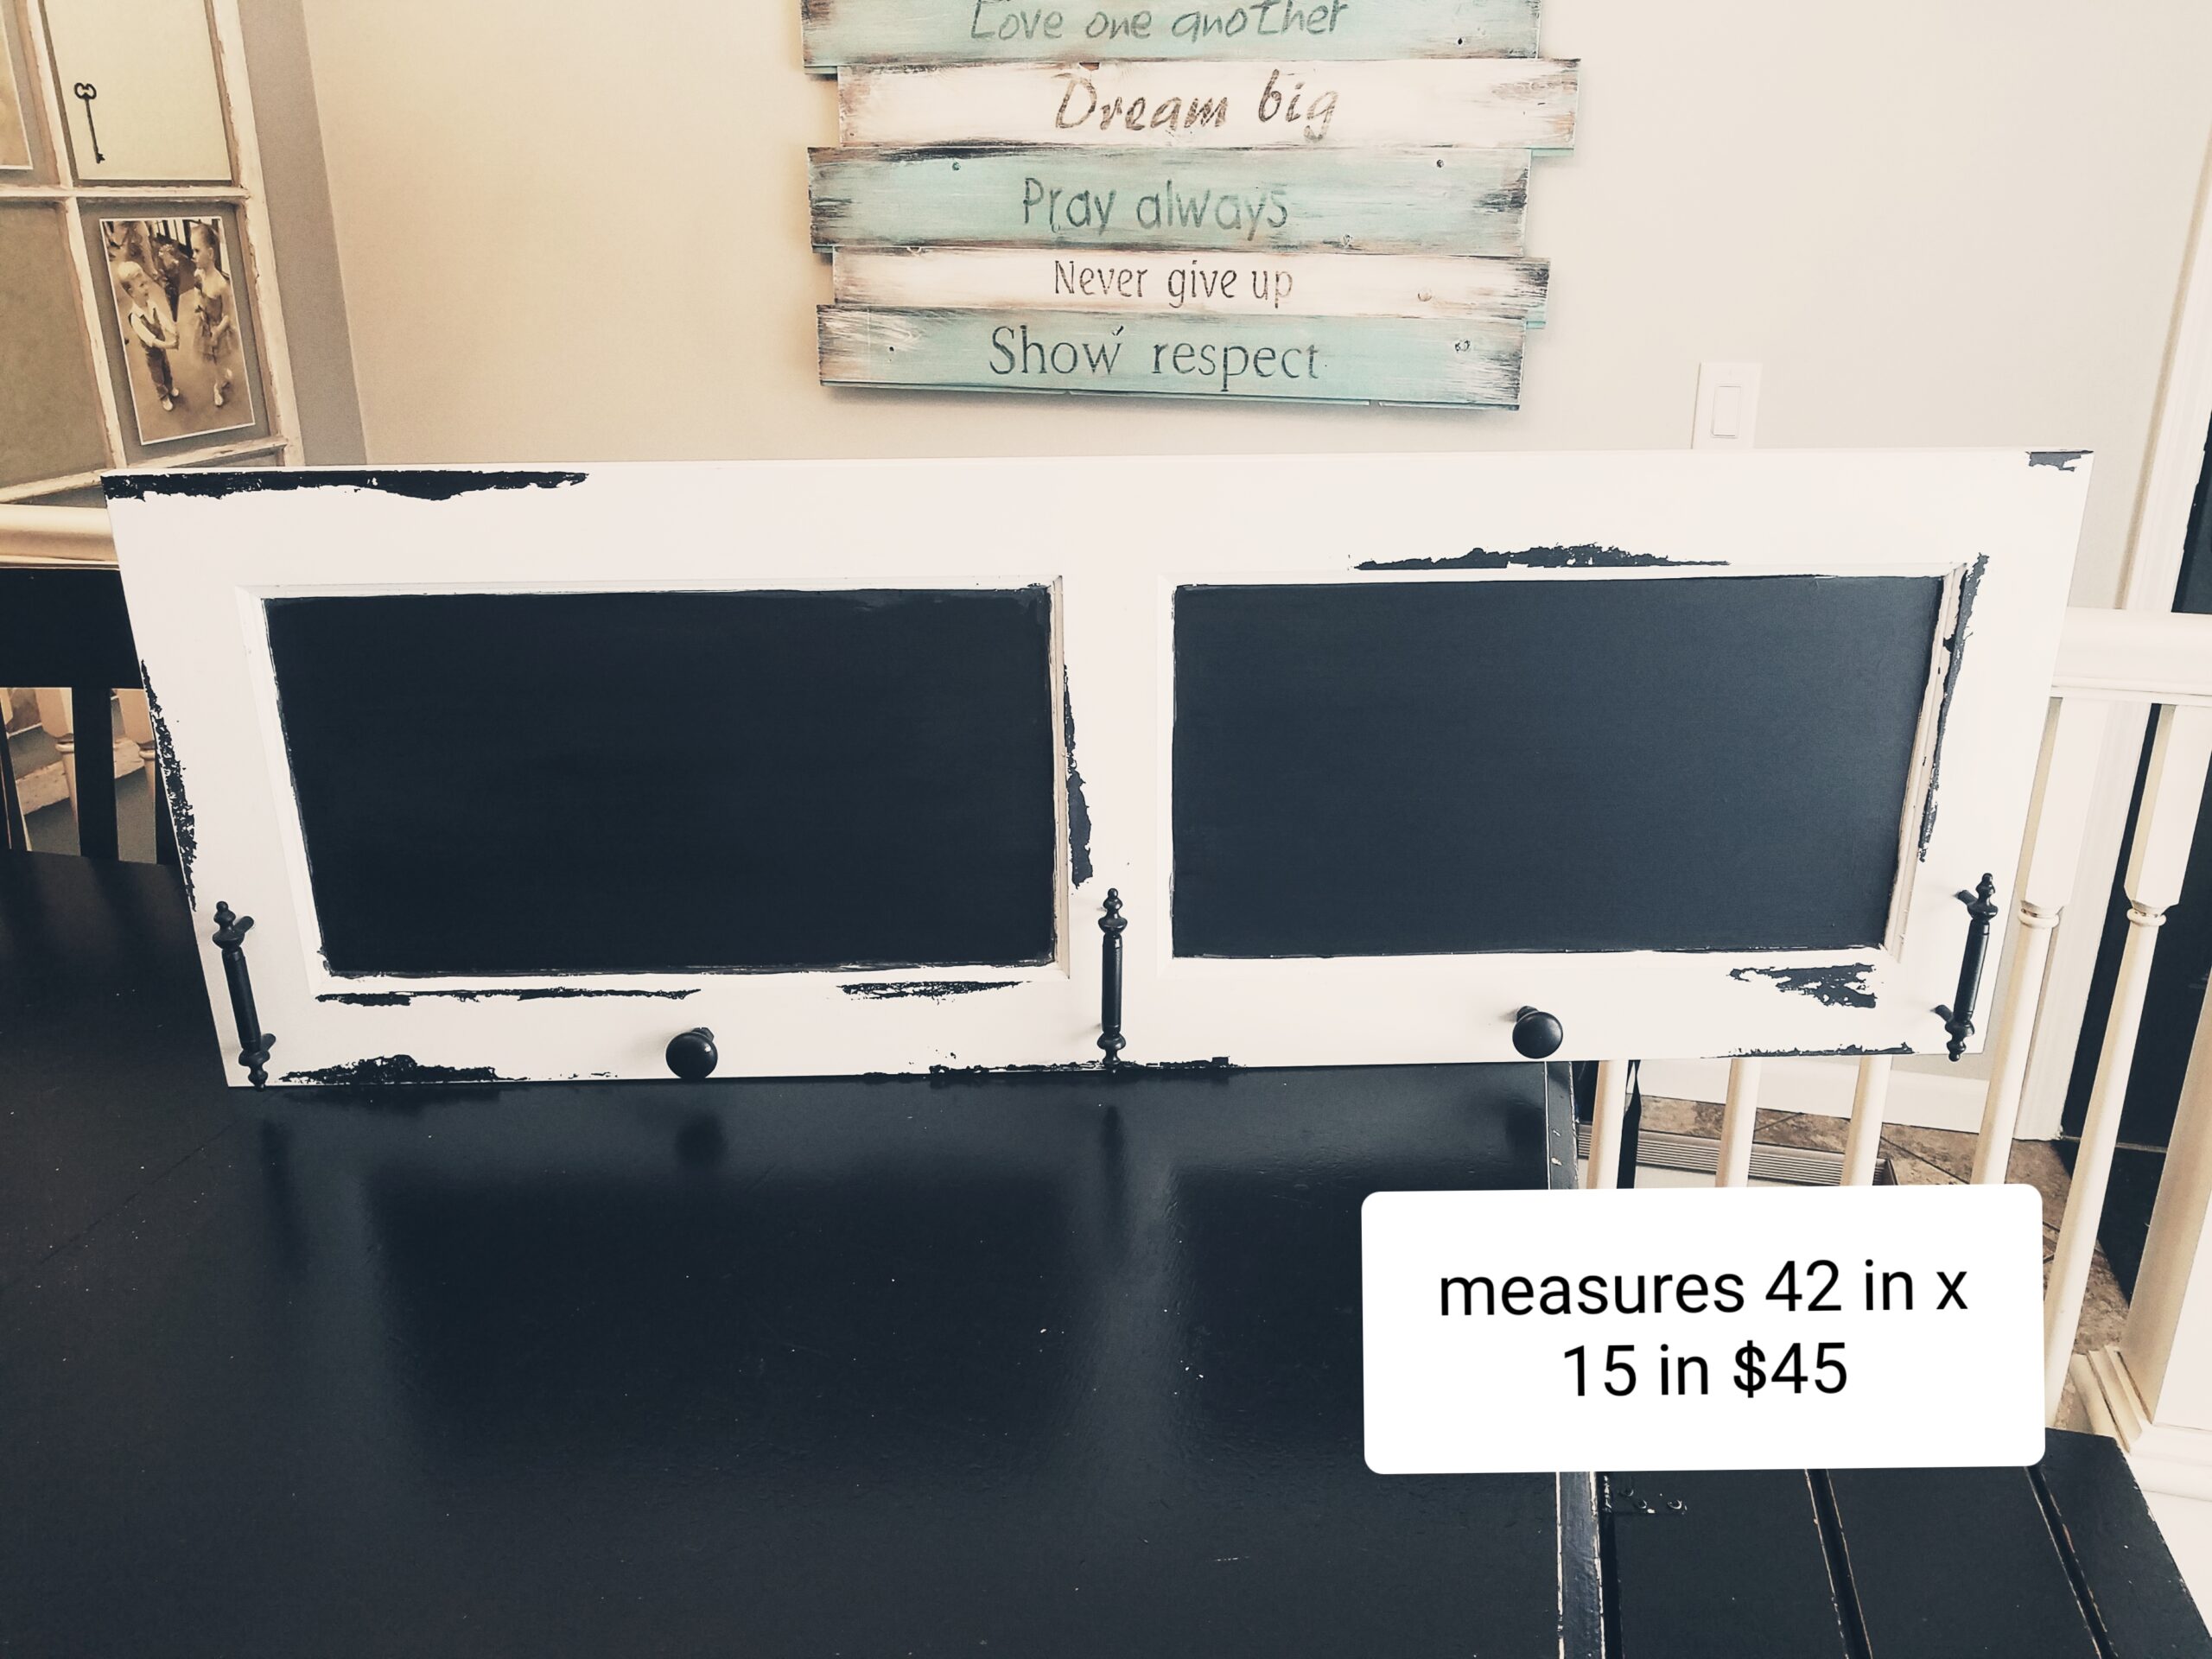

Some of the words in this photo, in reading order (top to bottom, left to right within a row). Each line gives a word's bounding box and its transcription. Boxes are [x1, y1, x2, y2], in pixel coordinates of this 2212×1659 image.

[970, 0, 1064, 40] Love
[1085, 10, 1153, 39] one
[1171, 0, 1349, 43] another
[1051, 73, 1229, 131] Dream
[1257, 69, 1339, 142] big
[1021, 176, 1116, 235] Pray
[1135, 180, 1289, 241] always
[1053, 260, 1150, 298] Never
[1166, 259, 1237, 308] give
[1252, 269, 1294, 308] up
[988, 325, 1122, 376] Show
[1151, 341, 1320, 392] respect
